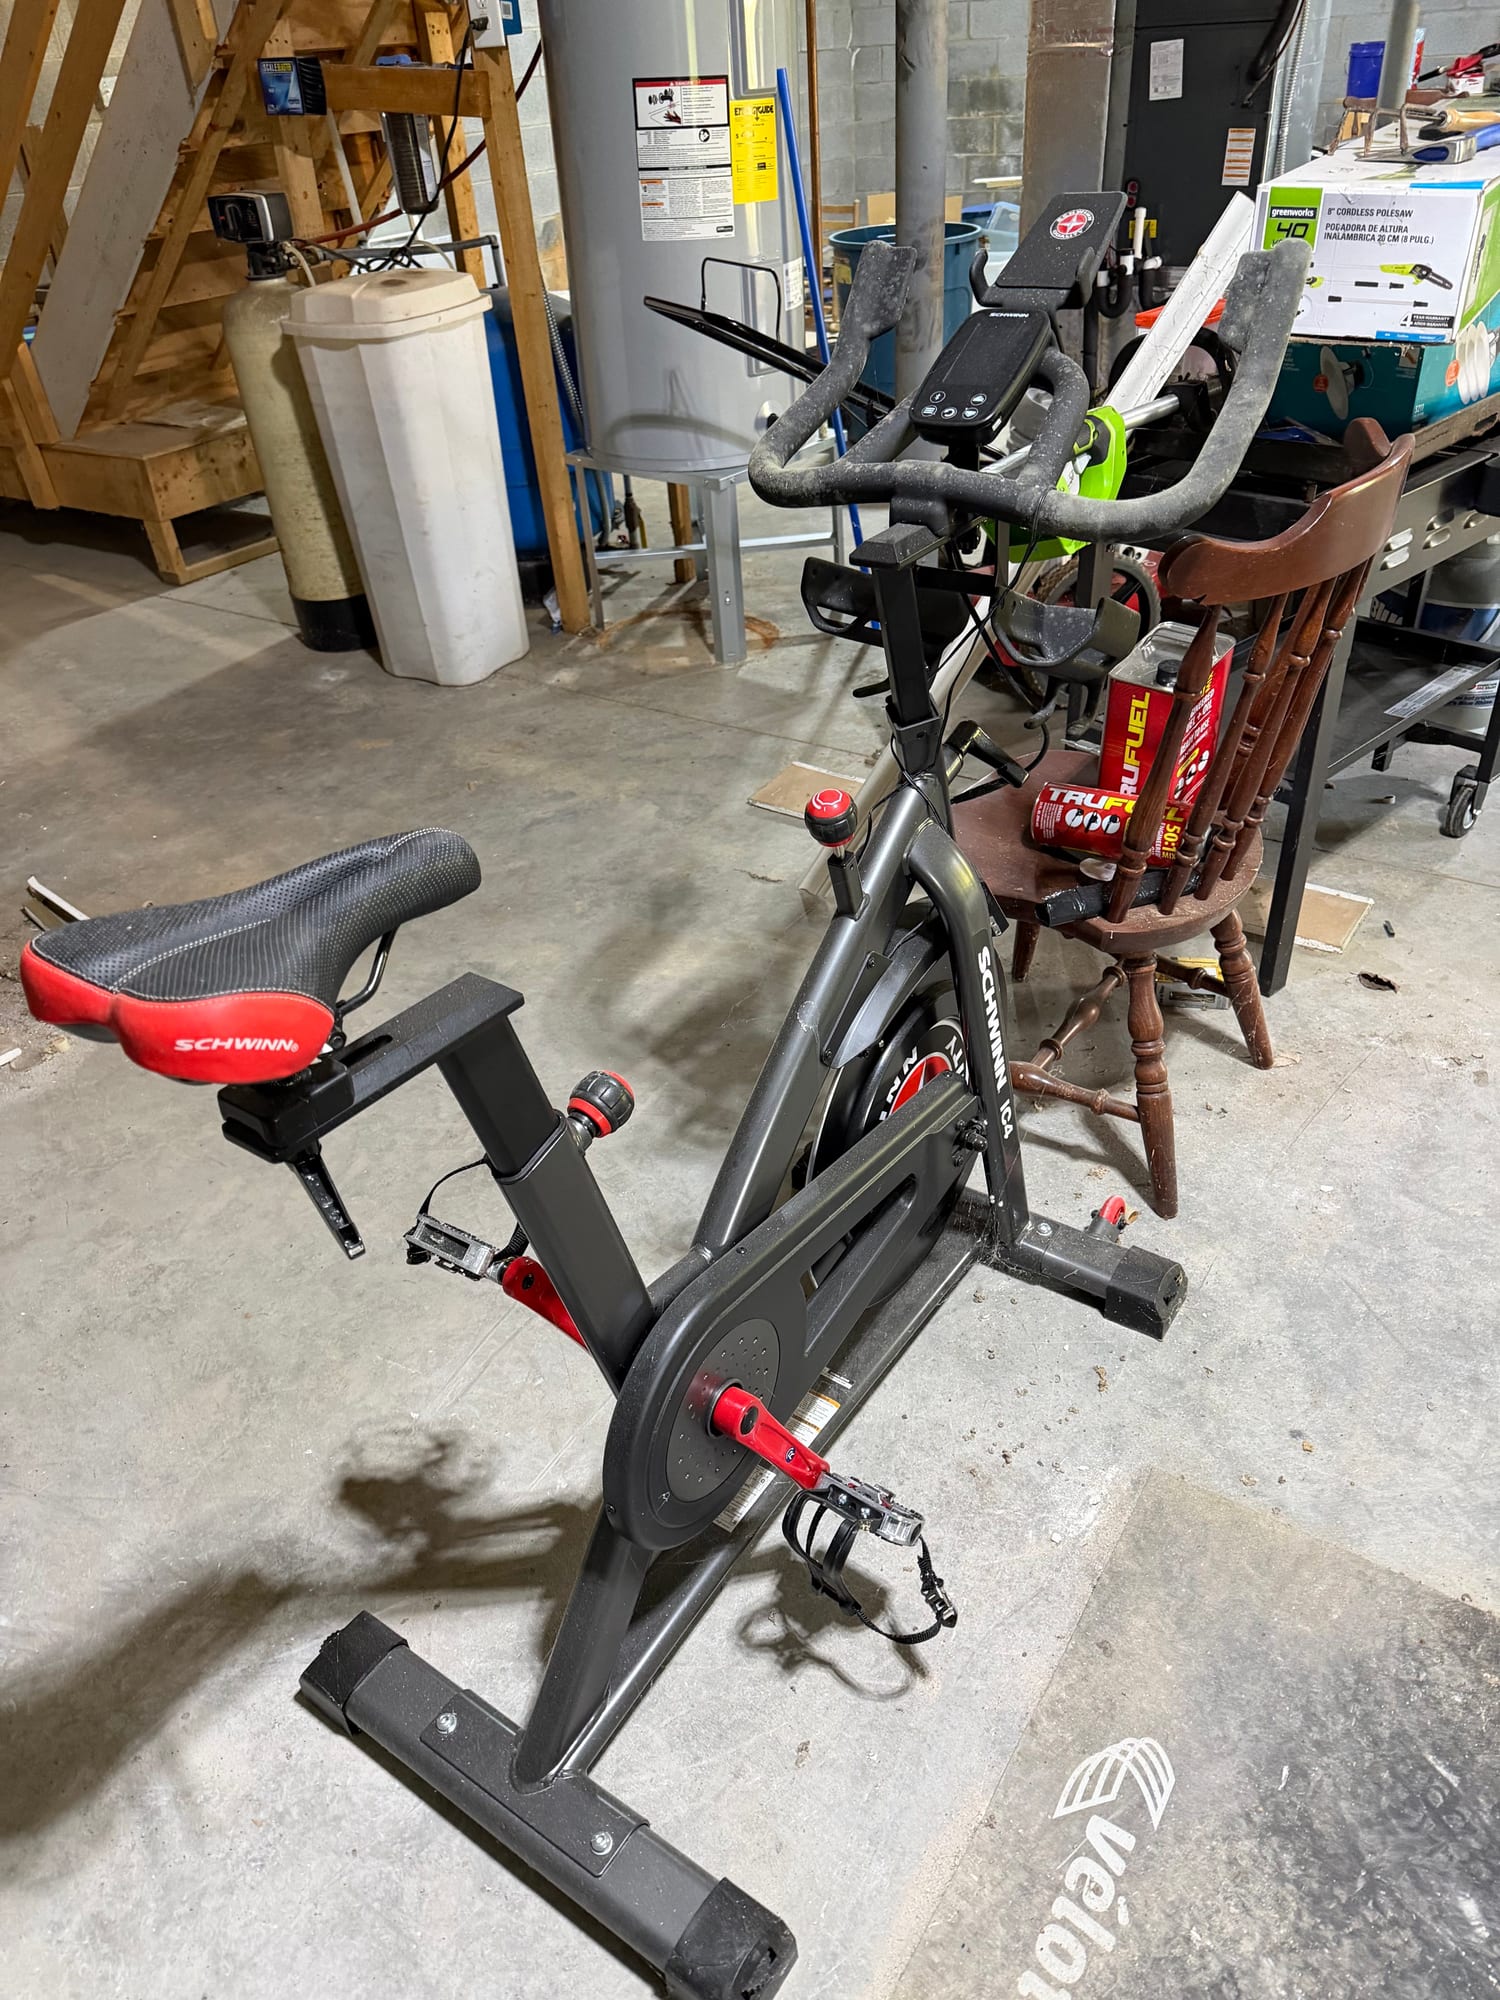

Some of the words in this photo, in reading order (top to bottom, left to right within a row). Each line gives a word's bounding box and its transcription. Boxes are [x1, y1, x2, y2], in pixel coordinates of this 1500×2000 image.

[1271, 208, 1314, 217] greenworks
[1336, 208, 1375, 217] CORDLESS
[1376, 209, 1414, 218] POLESAW
[1276, 222, 1309, 238] 40
[1368, 224, 1379, 232] DE
[1379, 224, 1408, 233] ALTURA
[1377, 234, 1386, 242] 20
[1387, 235, 1400, 243] CM
[1120, 692, 1151, 795] RUFUEL
[1161, 824, 1181, 851] 50:1
[978, 945, 1007, 1094] SCHWINN
[999, 1098, 1014, 1140] IC4
